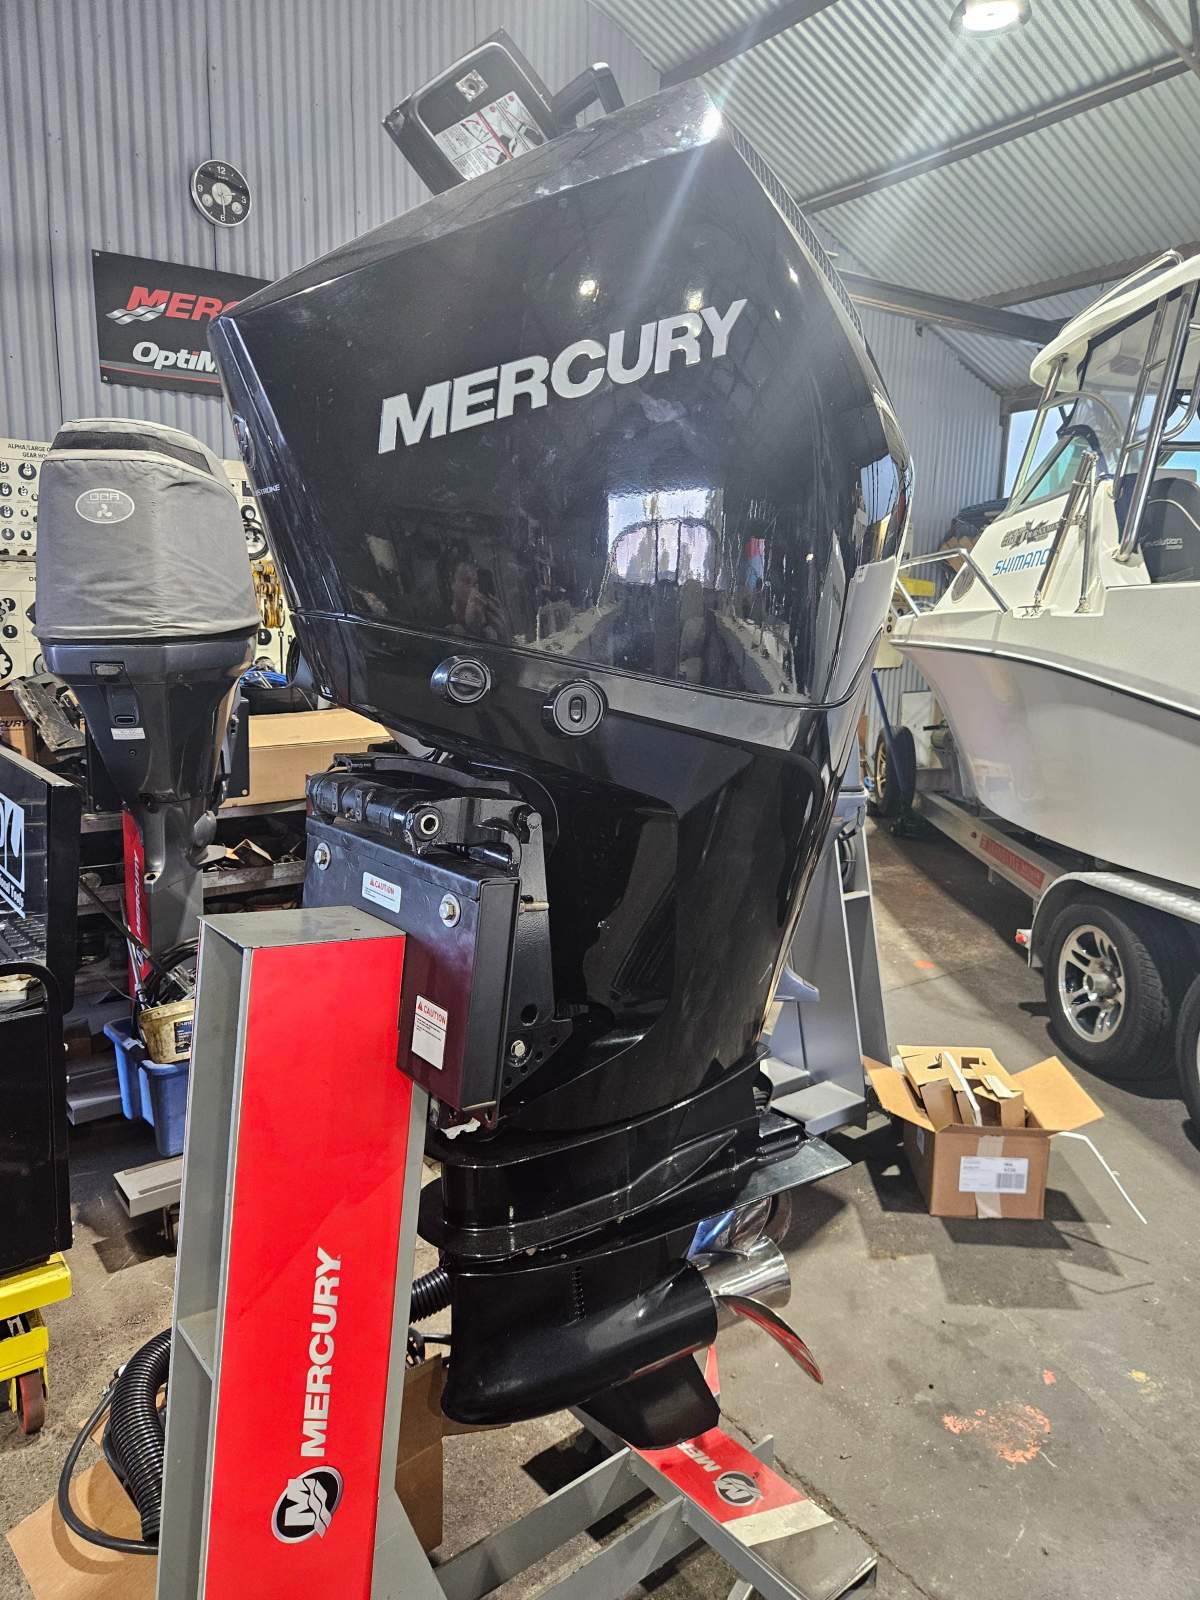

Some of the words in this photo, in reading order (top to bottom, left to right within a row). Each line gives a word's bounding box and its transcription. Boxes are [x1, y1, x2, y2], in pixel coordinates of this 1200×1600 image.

[217, 166, 226, 174] 12
[378, 298, 747, 454] MERCURY
[374, 880, 395, 896] CAUTION
[424, 1005, 446, 1025] CAUTION
[301, 1246, 342, 1457] MERCURY
